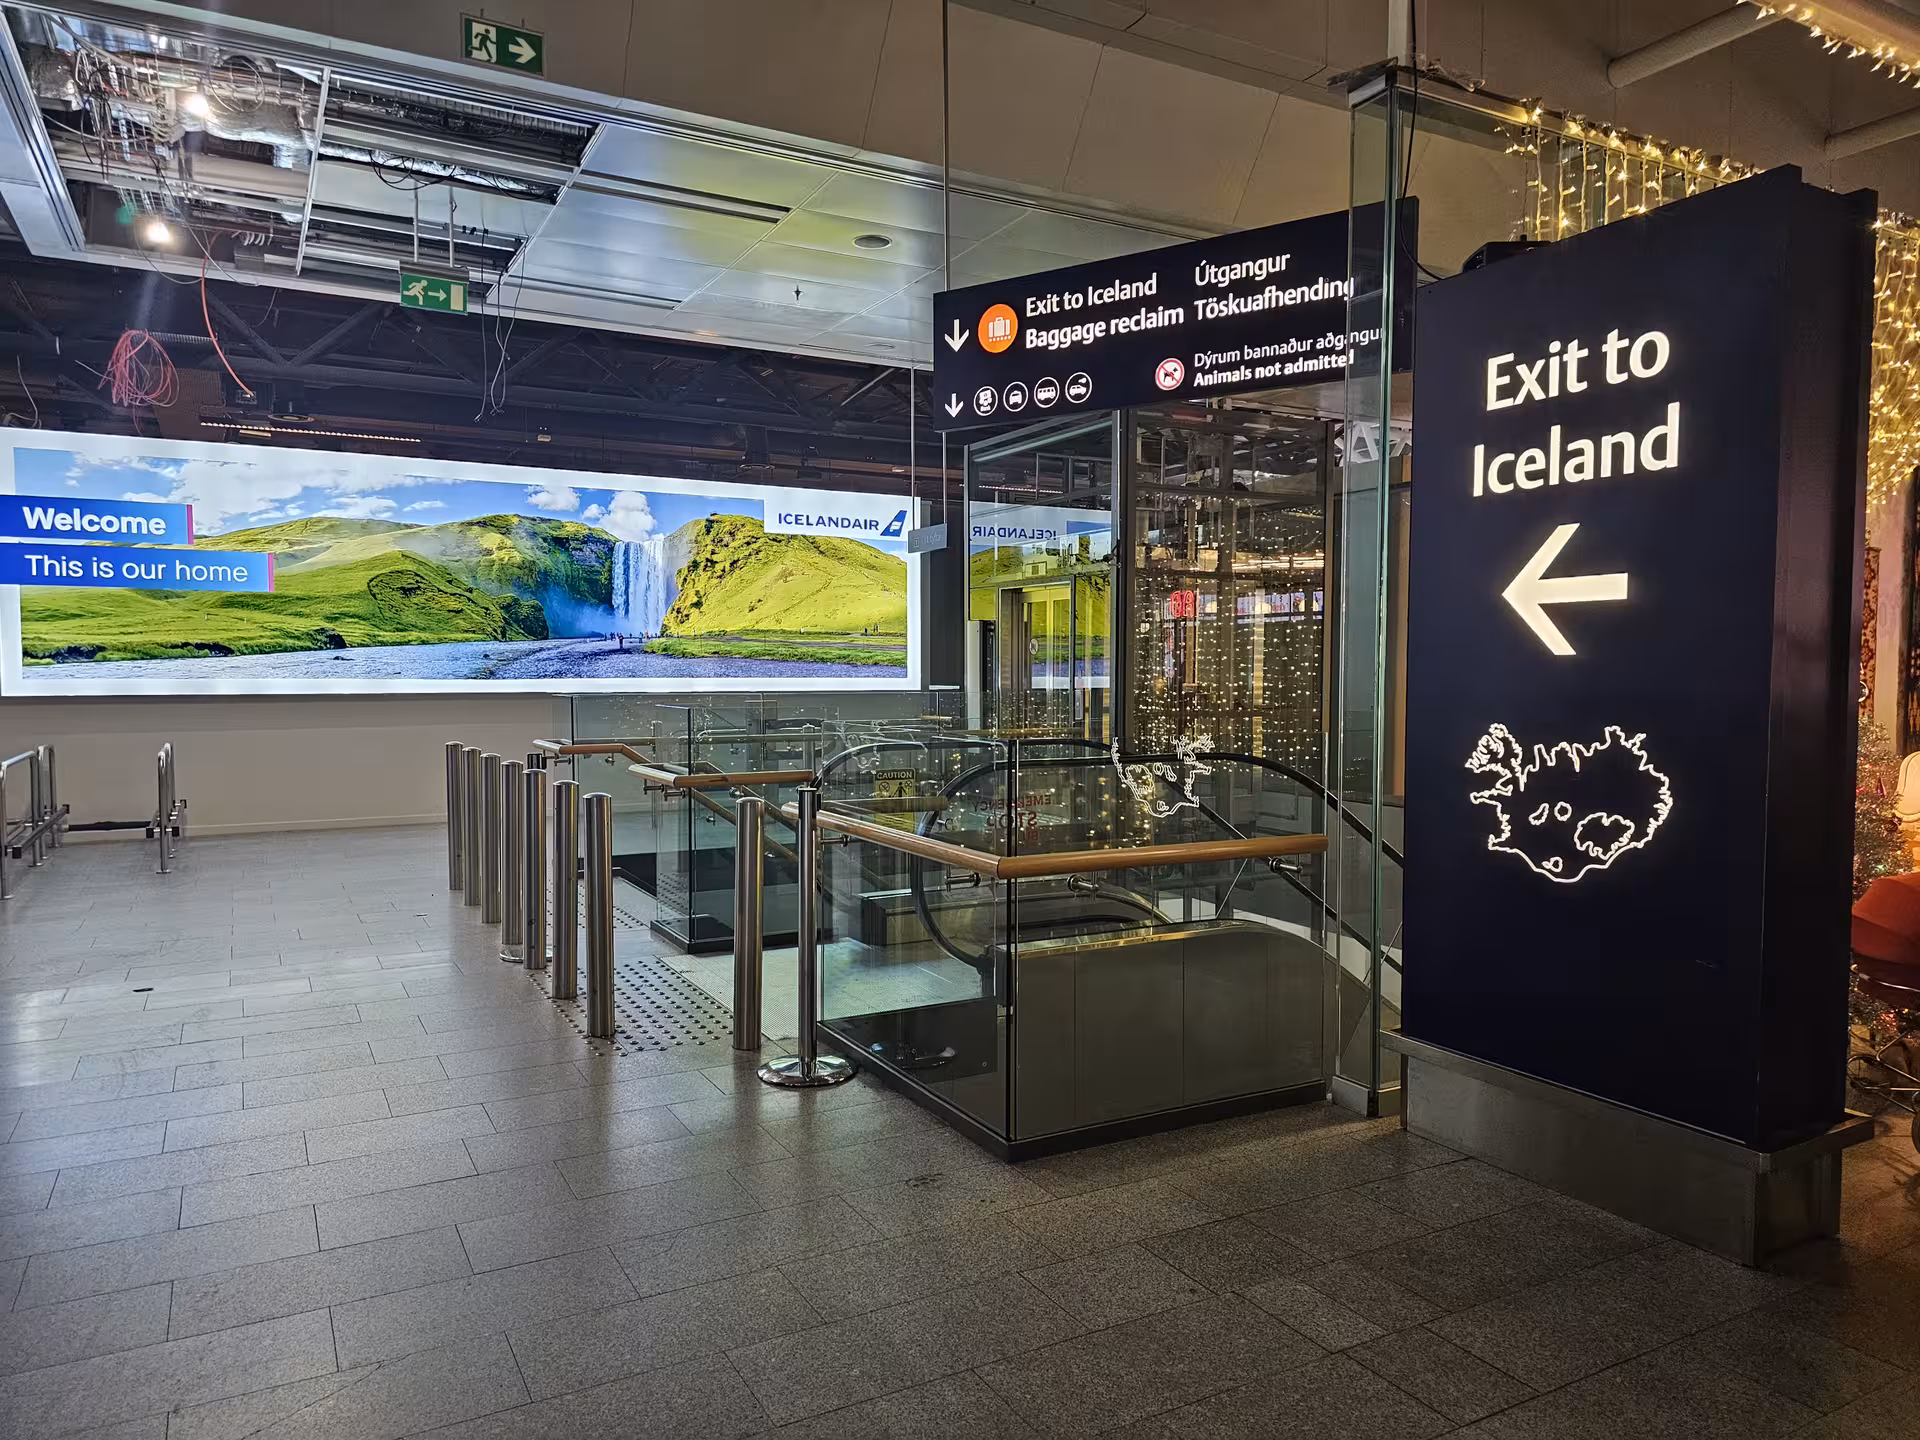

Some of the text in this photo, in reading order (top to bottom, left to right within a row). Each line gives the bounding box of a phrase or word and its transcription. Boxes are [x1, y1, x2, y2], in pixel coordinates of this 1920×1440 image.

[1194, 252, 1291, 286] Útgangur
[1026, 272, 1157, 318] Exit to Iceland
[1194, 276, 1355, 320] Töskuafhending
[1025, 305, 1185, 351] Baggage reclaim
[1194, 349, 1241, 369] Dýrum
[1243, 337, 1314, 361] bannaður
[1193, 364, 1253, 387] Animals
[1255, 361, 1282, 380] not
[1486, 328, 1670, 412] Exit to
[1472, 401, 1681, 498] Iceland
[23, 506, 167, 535] Welcome
[777, 513, 879, 531] ICELANDAIR
[24, 554, 249, 583] This is our home
[876, 771, 913, 780] CAUTION
